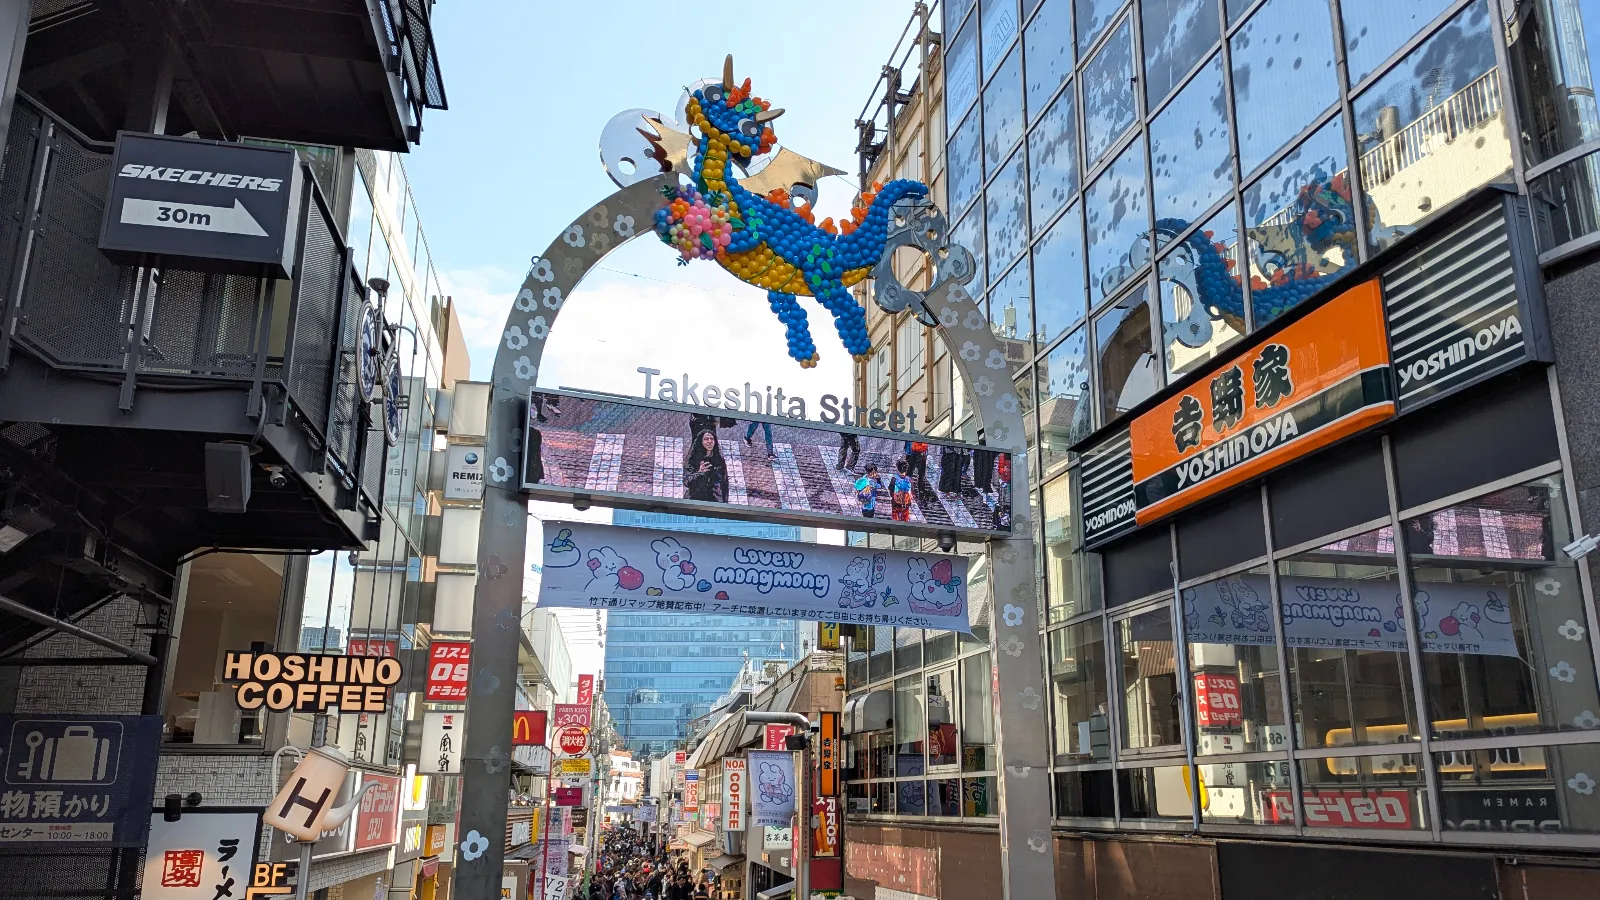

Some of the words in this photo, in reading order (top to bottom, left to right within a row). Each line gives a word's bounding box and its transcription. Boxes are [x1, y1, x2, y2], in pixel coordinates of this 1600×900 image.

[118, 163, 284, 192] SKECHERS
[156, 206, 211, 225] 30m
[1398, 314, 1523, 389] YOSHINOYA
[636, 366, 806, 420] Takeshita
[819, 394, 919, 434] Street
[1170, 343, 1295, 455] 吉野家
[1176, 411, 1299, 489] YOSHINOYA
[1085, 499, 1136, 533] YOSHINOYA
[224, 653, 402, 685] HOSHINO
[237, 682, 386, 711] COFFEE
[725, 760, 745, 768] NOA
[0, 789, 111, 819] 物預かり
[278, 777, 332, 828] H
[690, 783, 699, 803] NOA
[728, 772, 741, 829] COFFEE
[254, 863, 287, 887] BF
